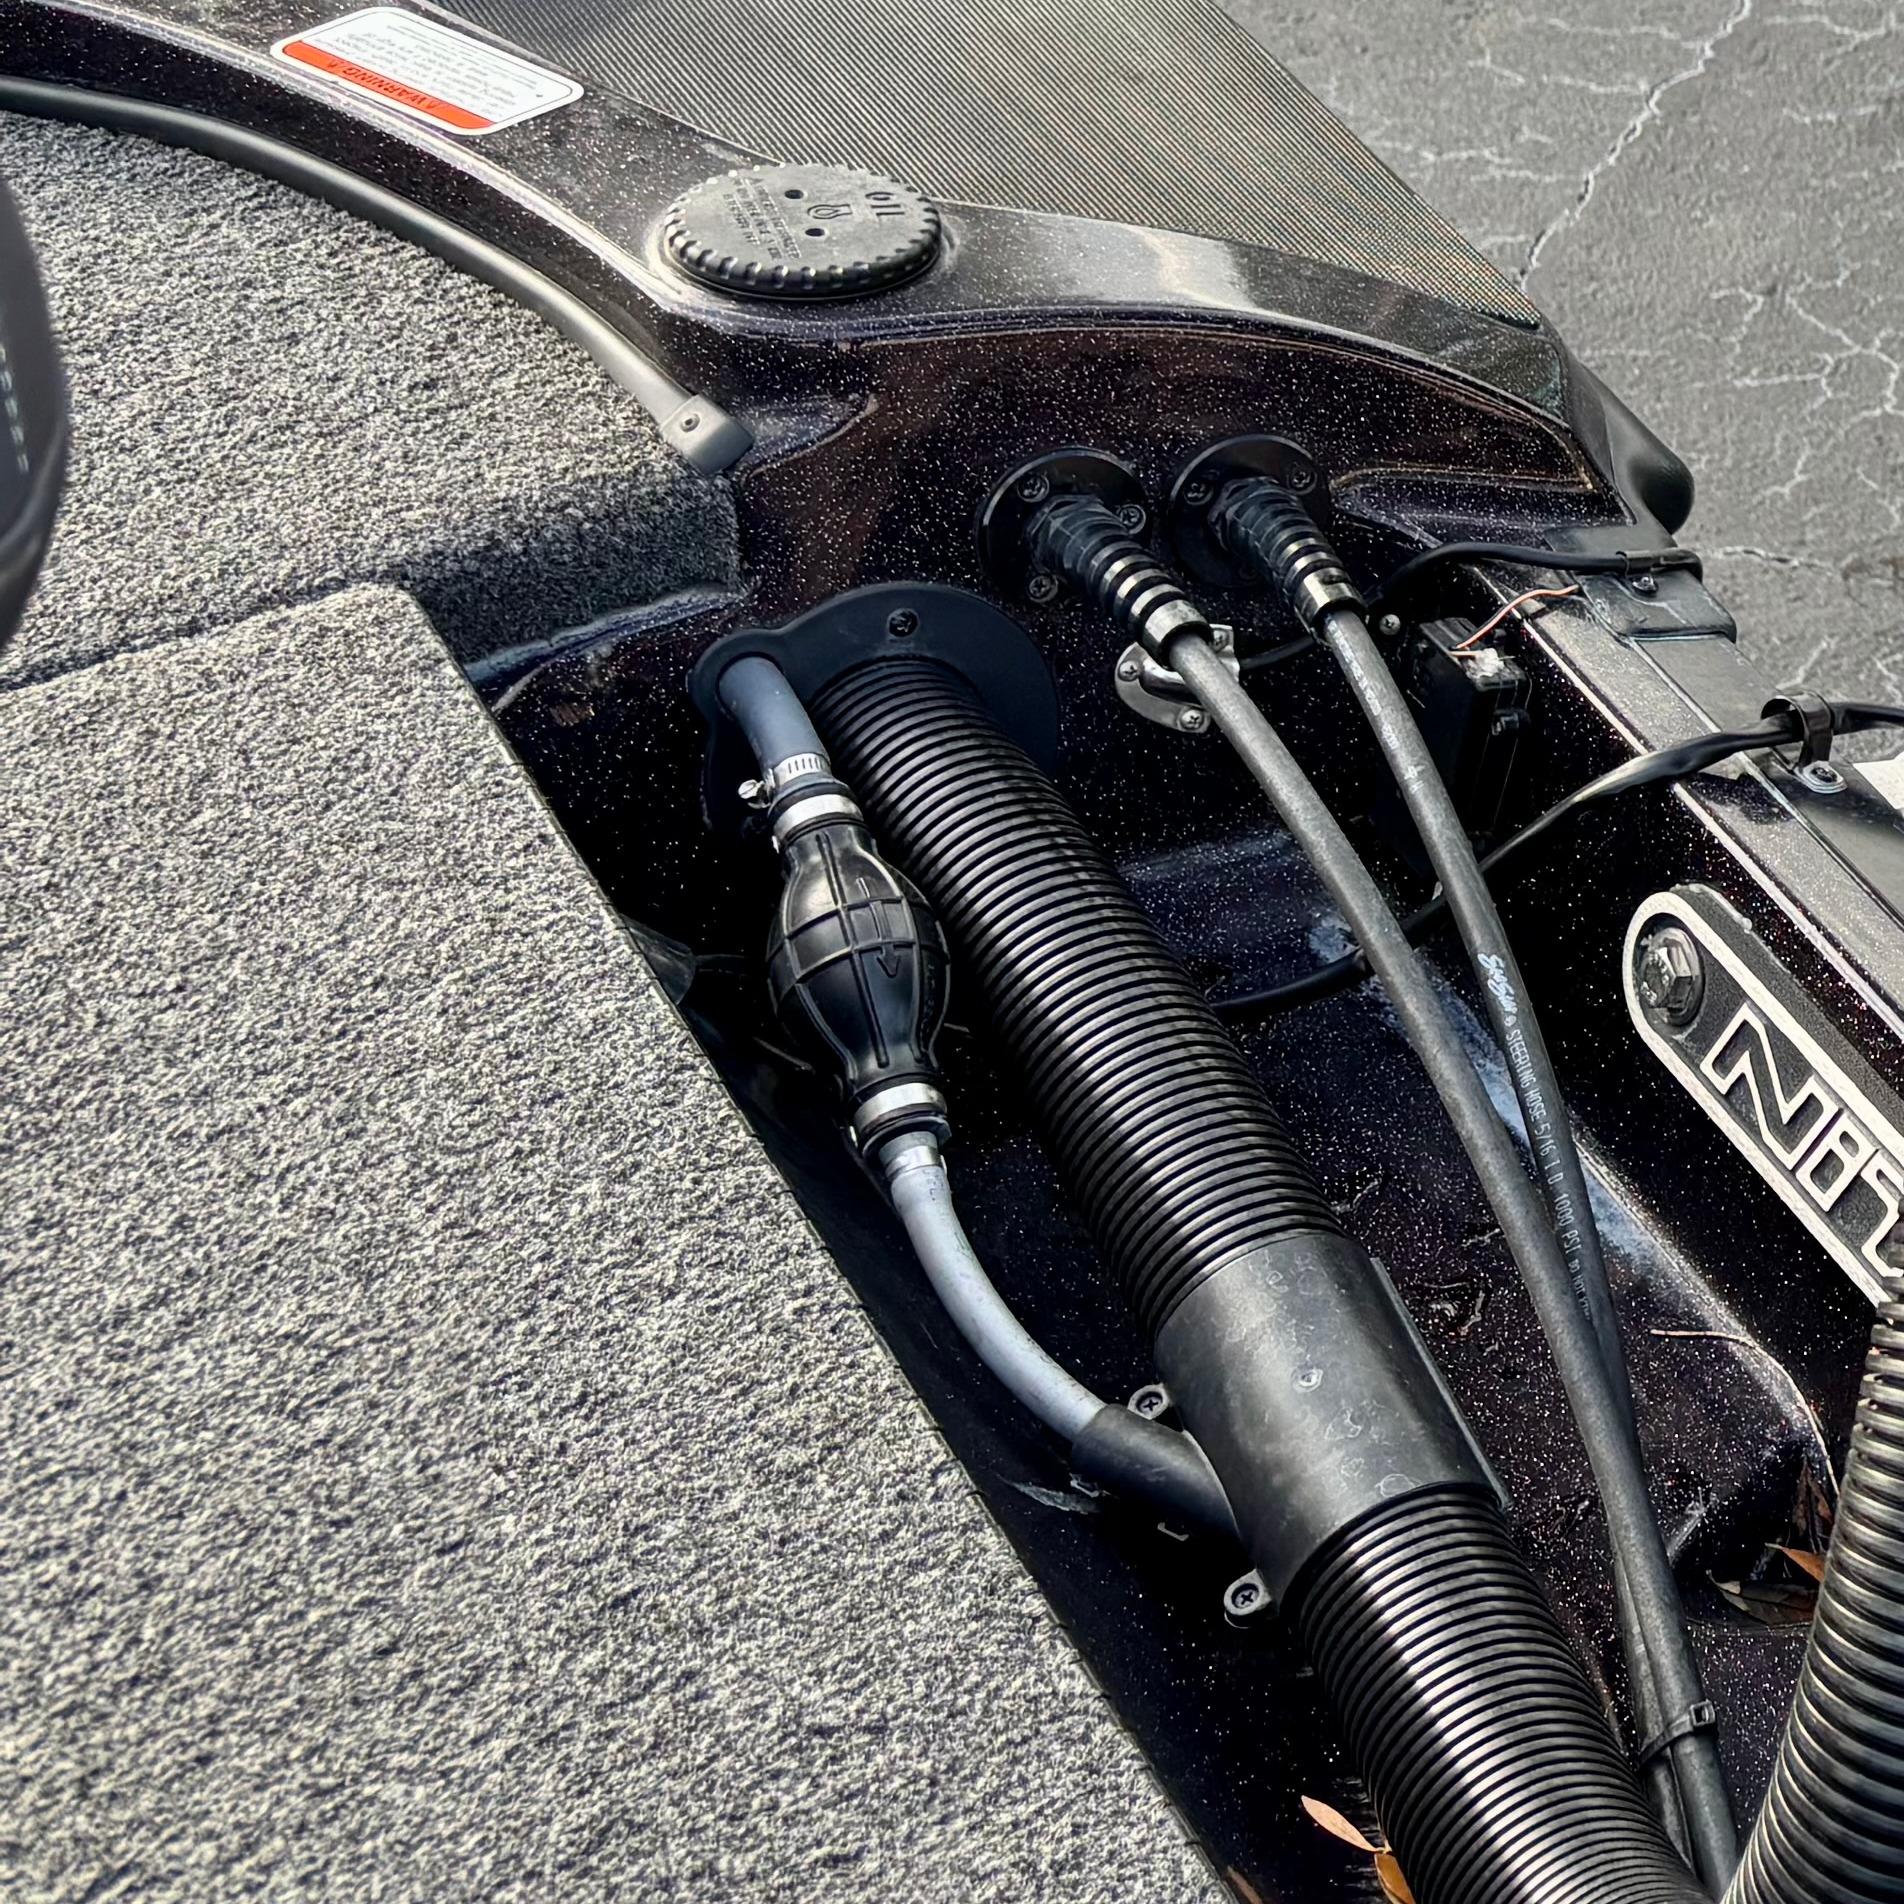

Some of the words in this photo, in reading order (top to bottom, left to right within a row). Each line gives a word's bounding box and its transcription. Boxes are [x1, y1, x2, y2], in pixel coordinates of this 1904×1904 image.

[1506, 1028, 1538, 1089] STEERING
[1524, 1086, 1548, 1123] HOSE
[1534, 1121, 1558, 1158] 5/16
[1553, 1192, 1575, 1227] 1000
[1561, 1228, 1583, 1255] PSI
